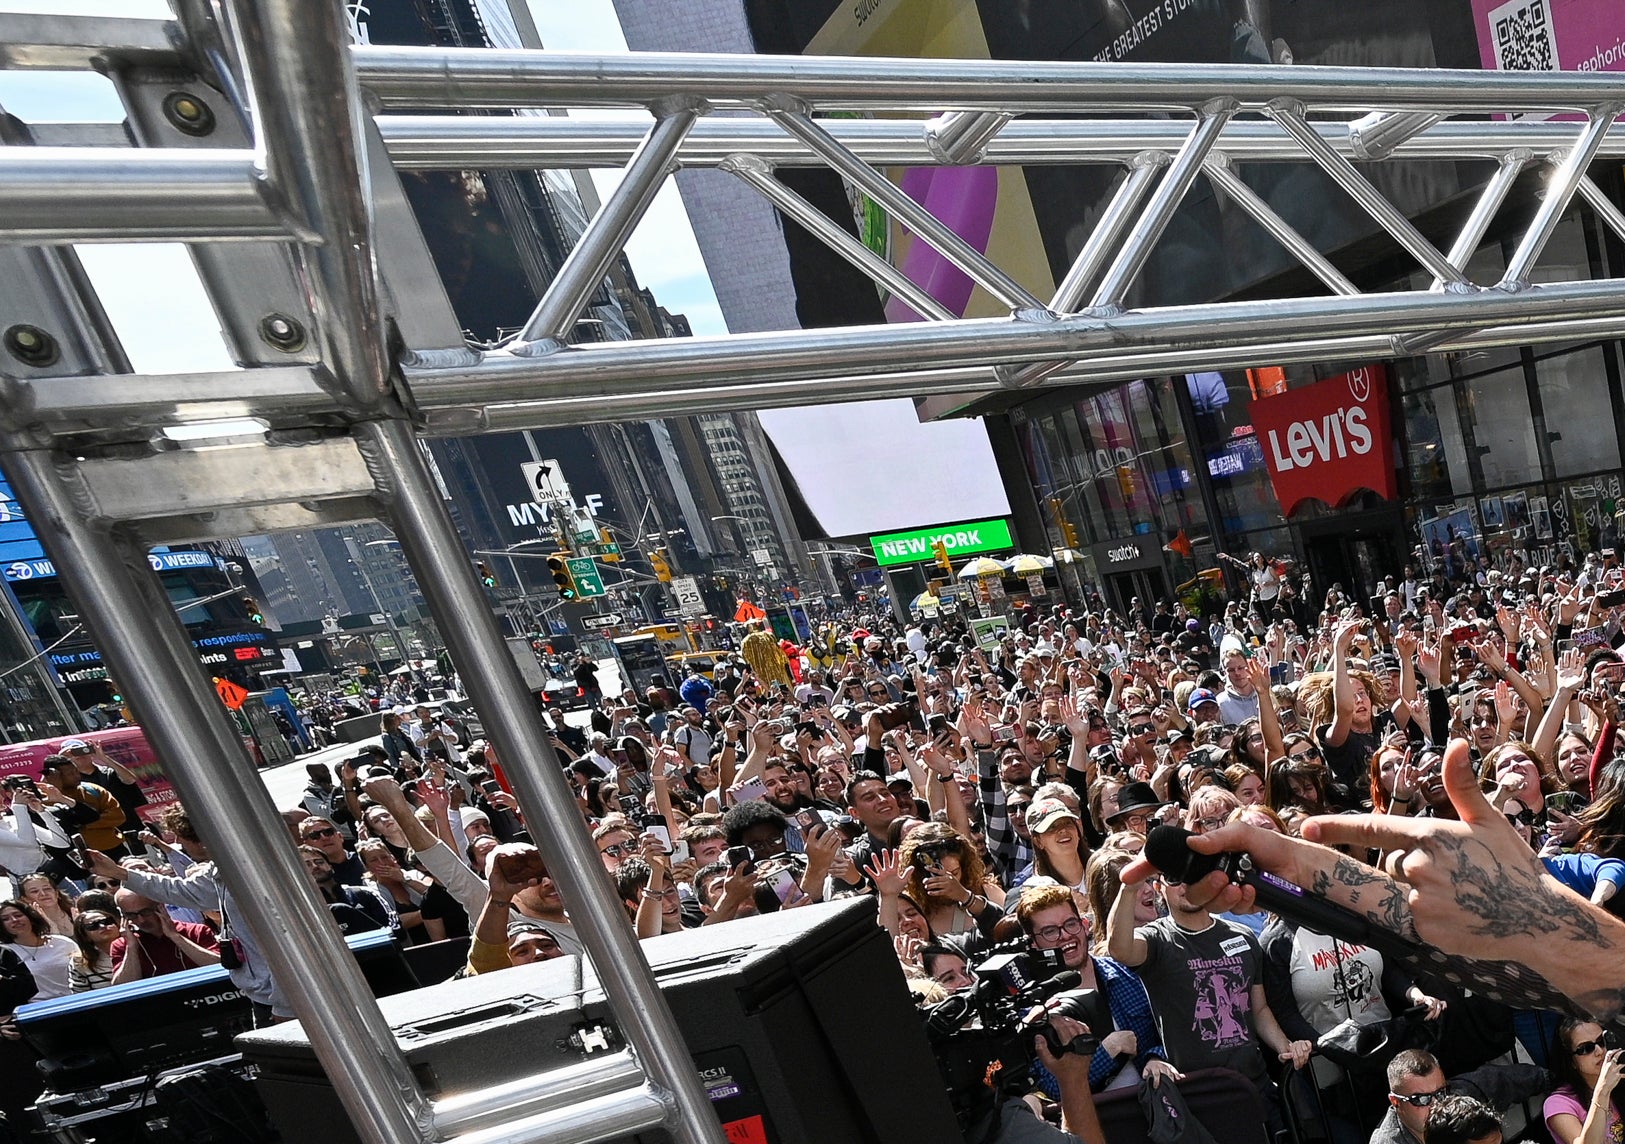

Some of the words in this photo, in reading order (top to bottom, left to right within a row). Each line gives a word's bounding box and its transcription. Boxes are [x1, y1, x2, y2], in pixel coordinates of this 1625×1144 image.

[1113, 6, 1162, 59] GREATEST
[539, 490, 563, 500] ONLY
[881, 536, 925, 558] NEW
[929, 530, 982, 554] YORK
[1108, 544, 1136, 563] swatch
[681, 592, 699, 604] 25
